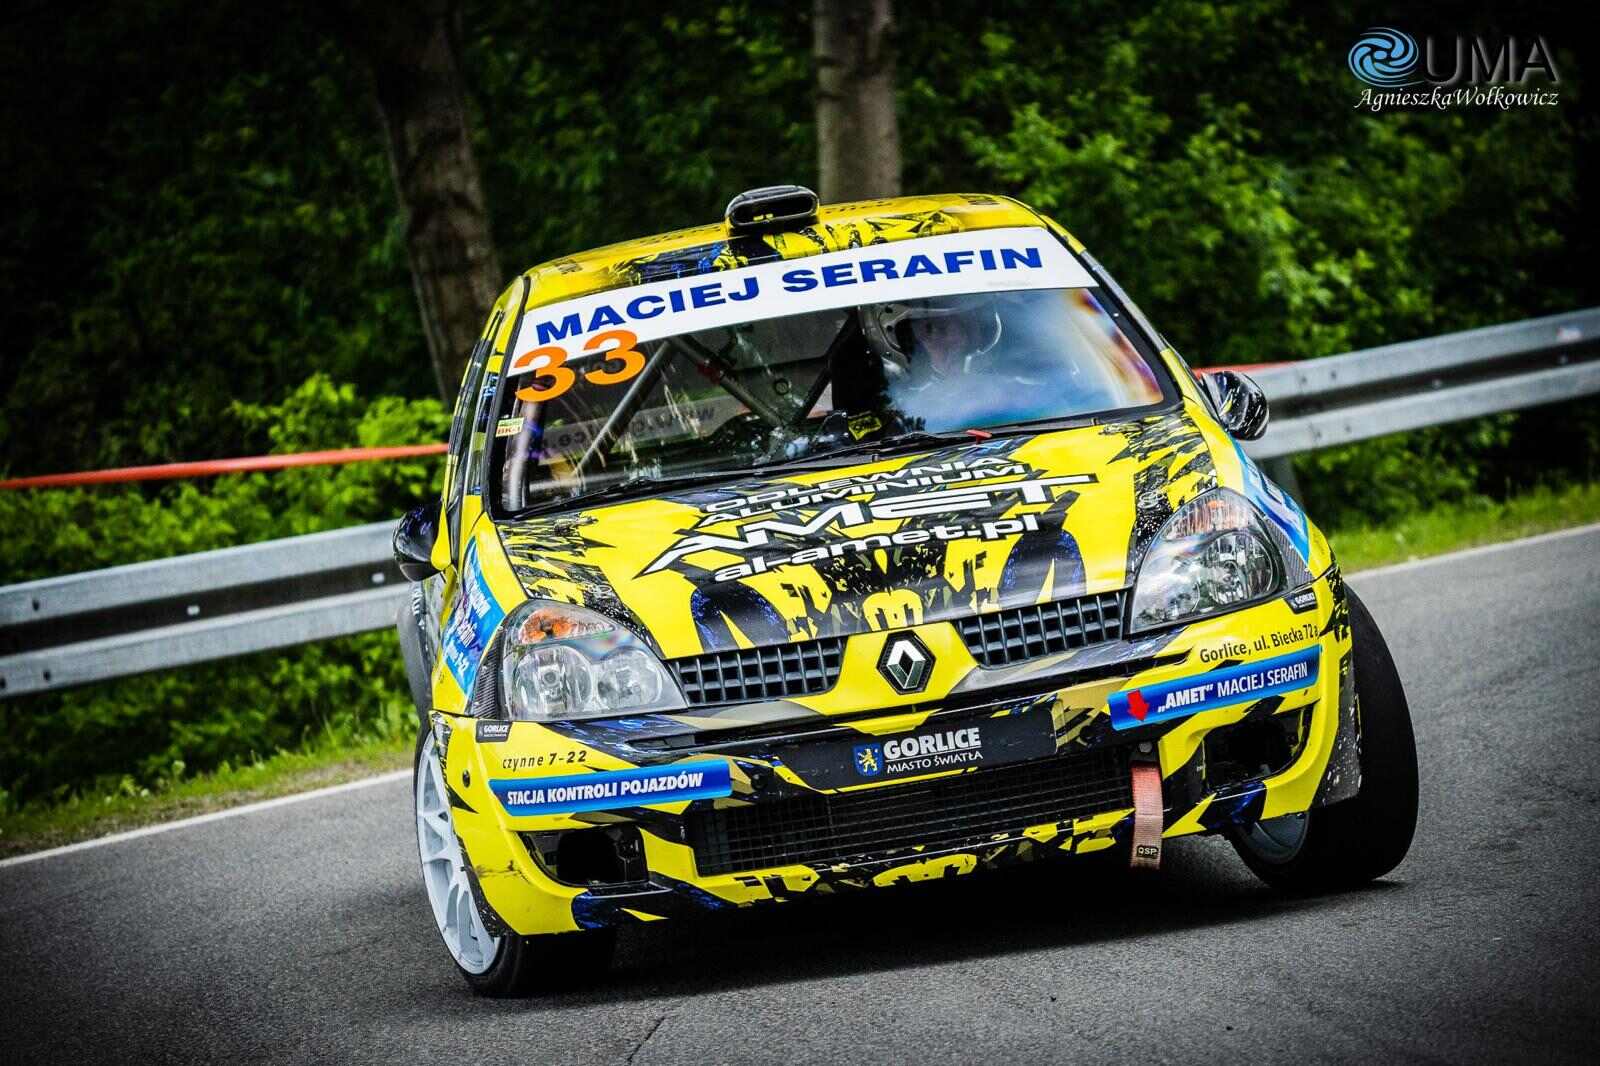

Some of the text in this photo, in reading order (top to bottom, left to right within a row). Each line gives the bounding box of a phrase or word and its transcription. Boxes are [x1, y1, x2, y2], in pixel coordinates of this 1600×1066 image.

[536, 248, 1042, 345] MACIEJ SERAFIN
[514, 329, 646, 402] 33
[698, 464, 1025, 528] ALUMINIUM
[706, 457, 1010, 513] ODLEWNIA
[643, 474, 1090, 575] AMET
[714, 514, 1040, 582] al-amet.pl
[1200, 641, 1252, 663] Gorlice,
[1254, 635, 1270, 651] ul.
[1271, 627, 1304, 647] Biecka
[1217, 673, 1264, 698] MACIEJ
[1268, 662, 1308, 686] SERAFIN
[502, 750, 587, 772] czynne 7-22
[883, 727, 981, 760] GORLICE
[887, 750, 983, 773] MIASTO ŚWIATŁA
[507, 770, 703, 805] STACJA KONTROLI POJAZDÓW
